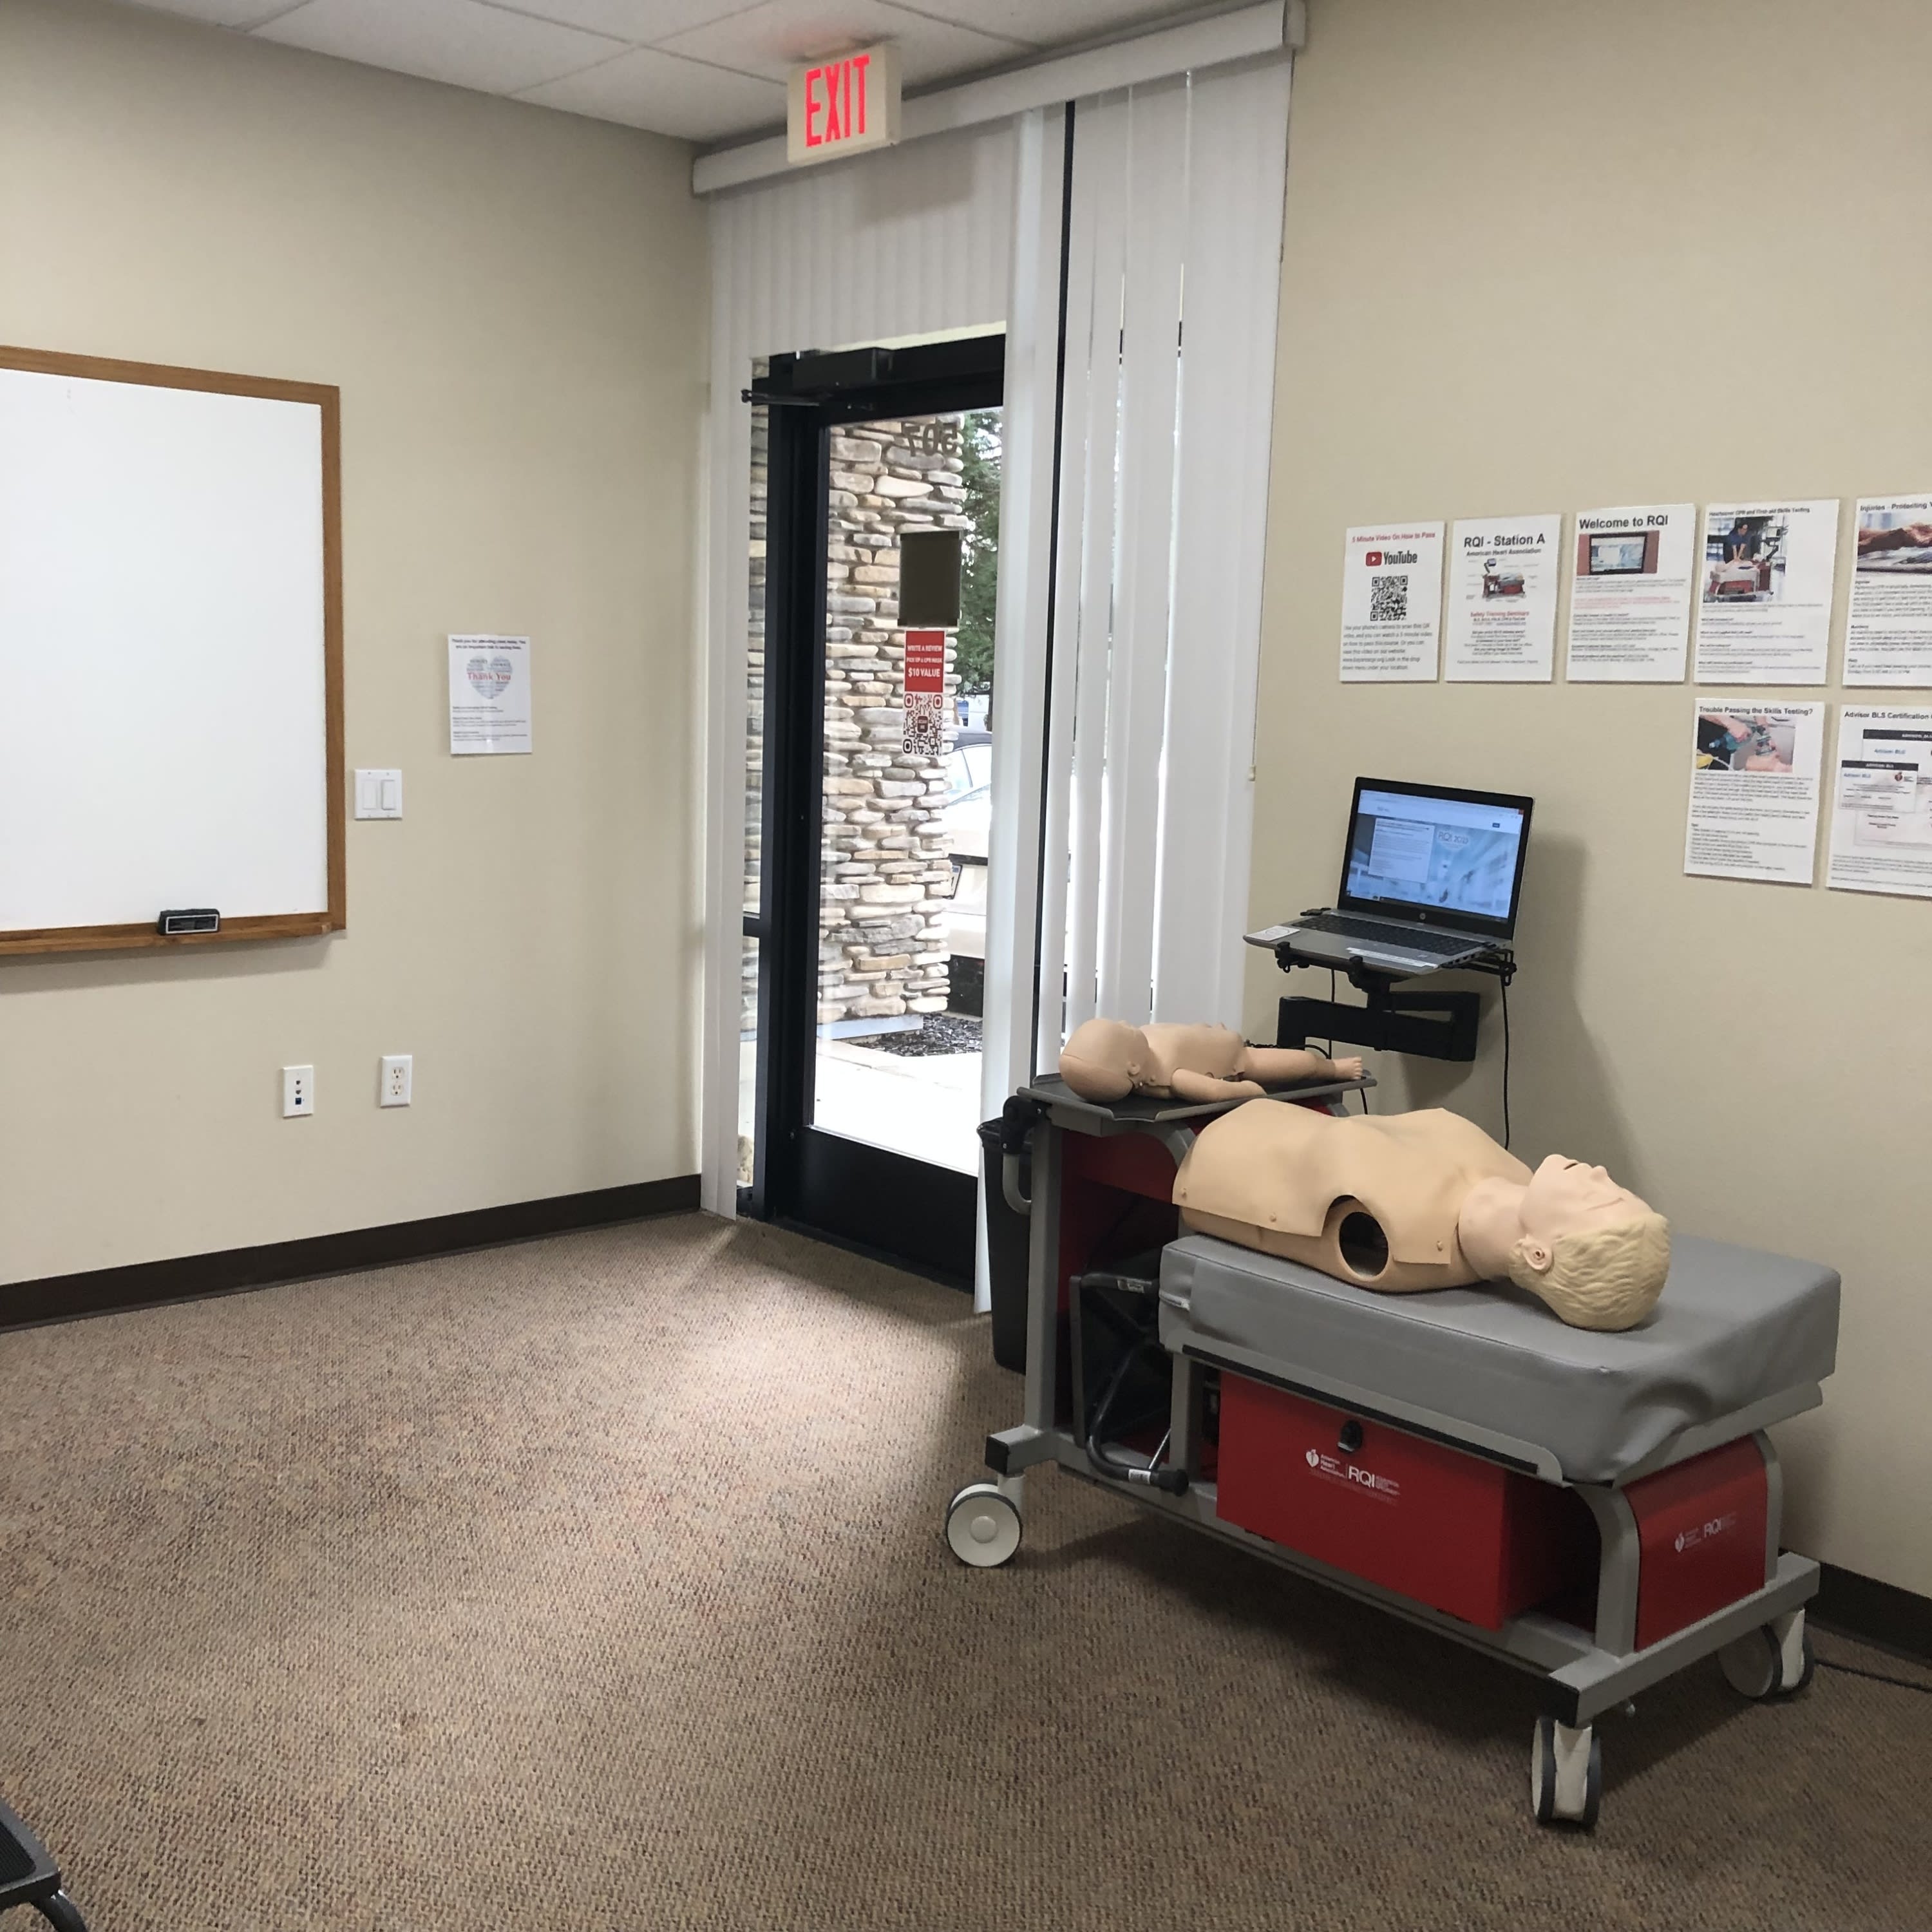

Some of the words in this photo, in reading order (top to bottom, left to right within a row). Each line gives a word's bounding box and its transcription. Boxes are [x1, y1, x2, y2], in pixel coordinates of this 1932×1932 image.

[806, 53, 871, 147] EXIT
[1579, 516, 1629, 529] Welcome
[1633, 517, 1644, 527] to
[1647, 515, 1668, 526] RQI
[1464, 536, 1484, 548] RQI
[1494, 534, 1533, 546] Station
[1537, 533, 1545, 544] A
[1384, 550, 1417, 565] YouTube
[467, 672, 493, 681] Thank
[496, 672, 511, 681] You
[908, 668, 920, 677] $10
[920, 668, 940, 677] VALUE
[1725, 707, 1750, 715] Passing
[1783, 707, 1814, 716] Testing?
[1321, 1454, 1340, 1464] American
[1321, 1459, 1335, 1469] Heart
[1320, 1465, 1345, 1478] Association
[1349, 1465, 1375, 1488] RQI
[1704, 1518, 1721, 1538] RQI
